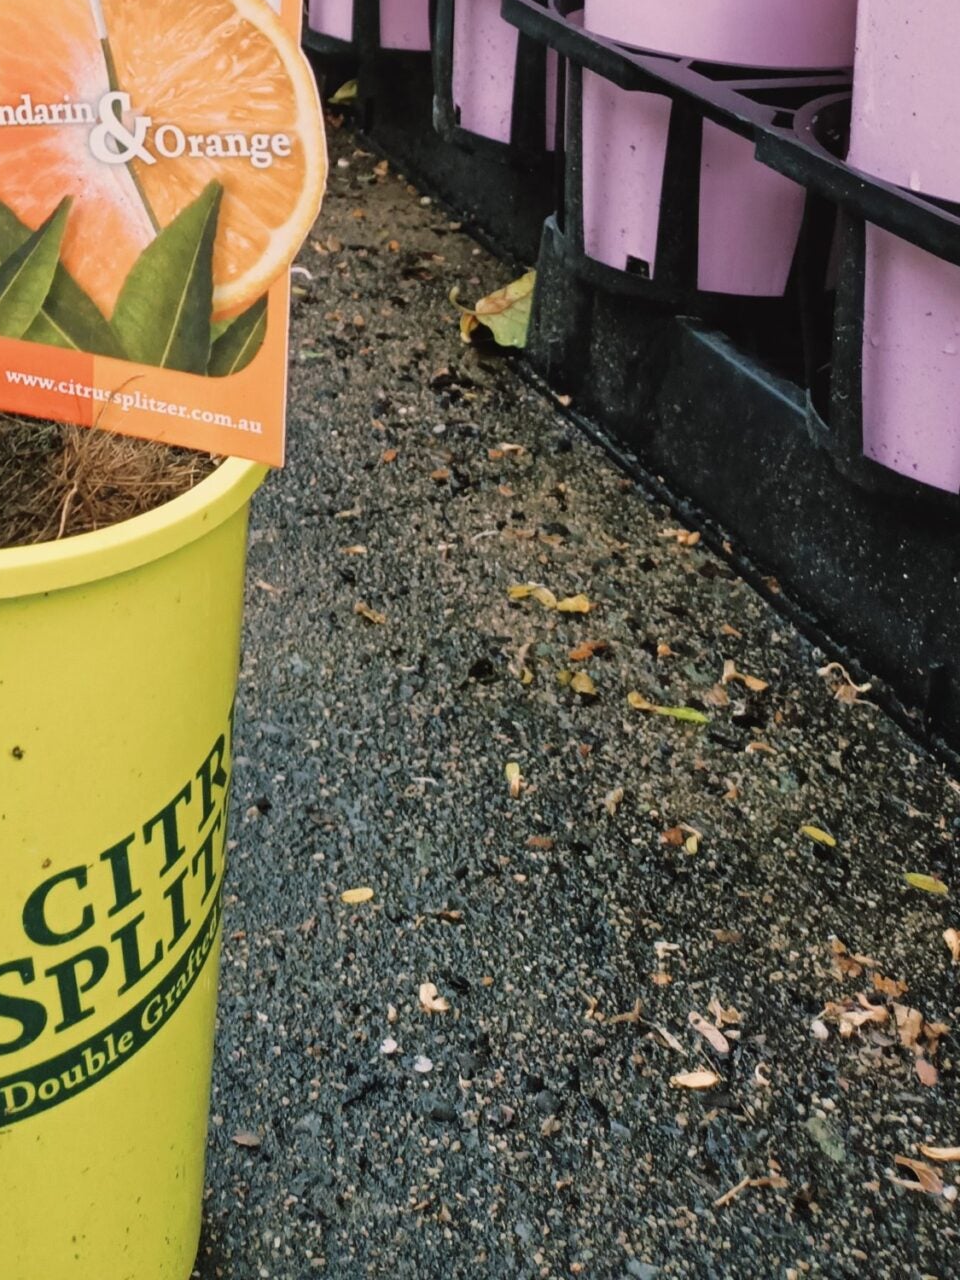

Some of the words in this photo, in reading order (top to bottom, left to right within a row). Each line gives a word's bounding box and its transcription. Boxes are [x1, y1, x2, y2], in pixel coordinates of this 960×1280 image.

[91, 90, 157, 166] &
[154, 124, 291, 168] Orange
[5, 370, 263, 435] www.citrussplitzer.com.au
[22, 695, 234, 948] CITR
